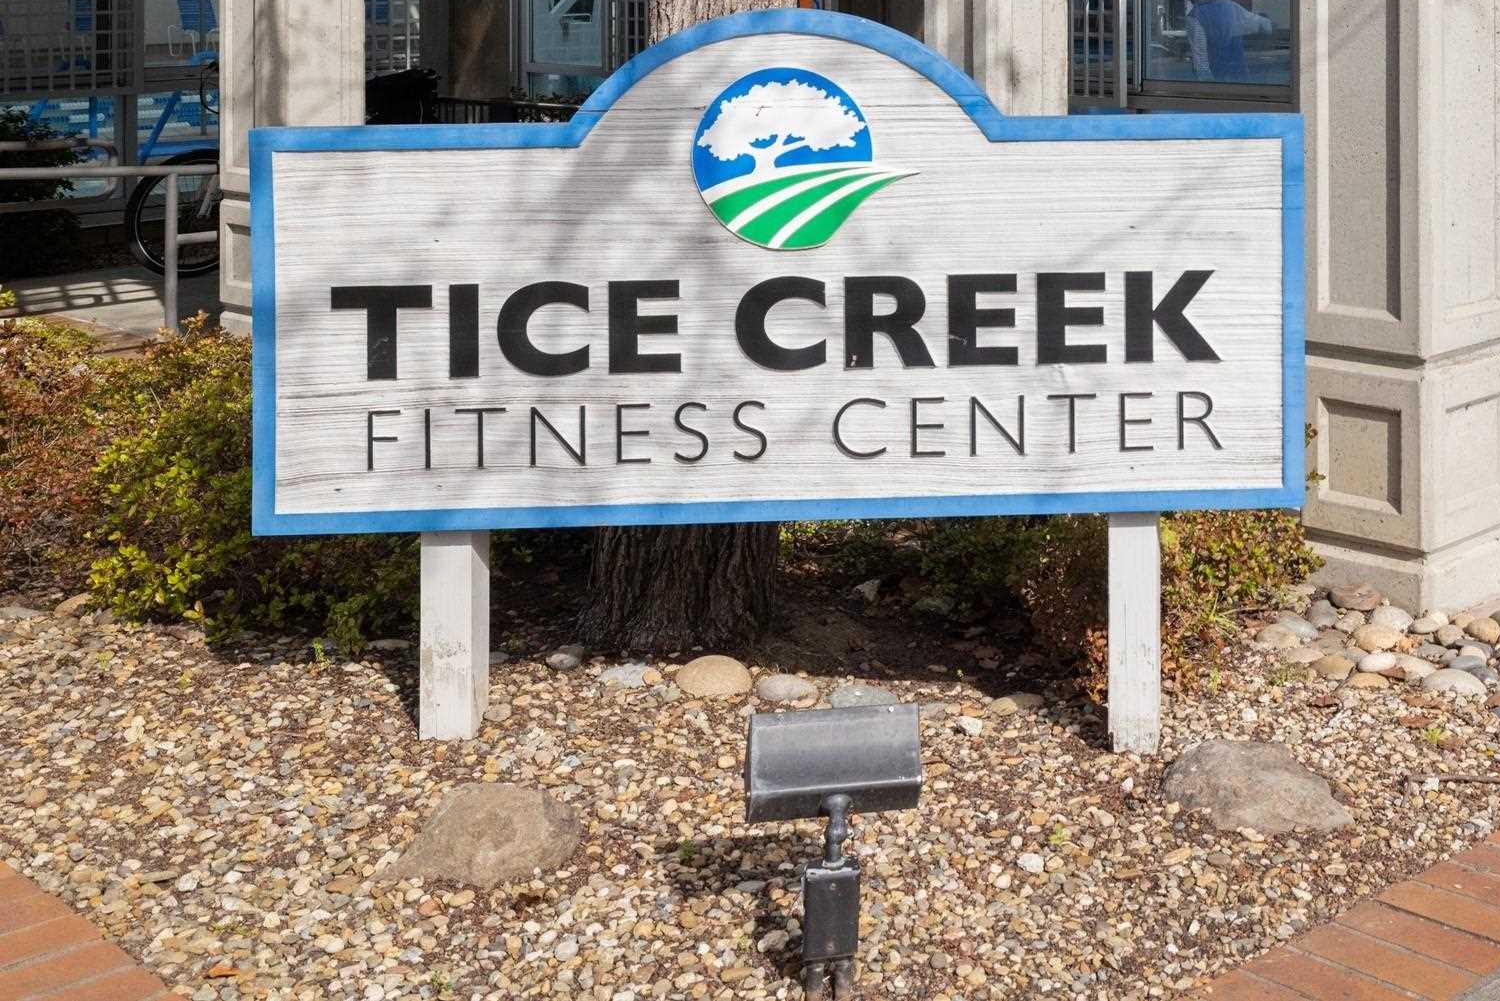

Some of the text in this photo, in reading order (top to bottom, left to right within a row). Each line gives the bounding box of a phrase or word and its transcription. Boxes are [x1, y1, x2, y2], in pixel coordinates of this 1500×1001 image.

[330, 270, 1222, 380] TICE CREEK
[367, 391, 1223, 471] FITNESS CENTER
